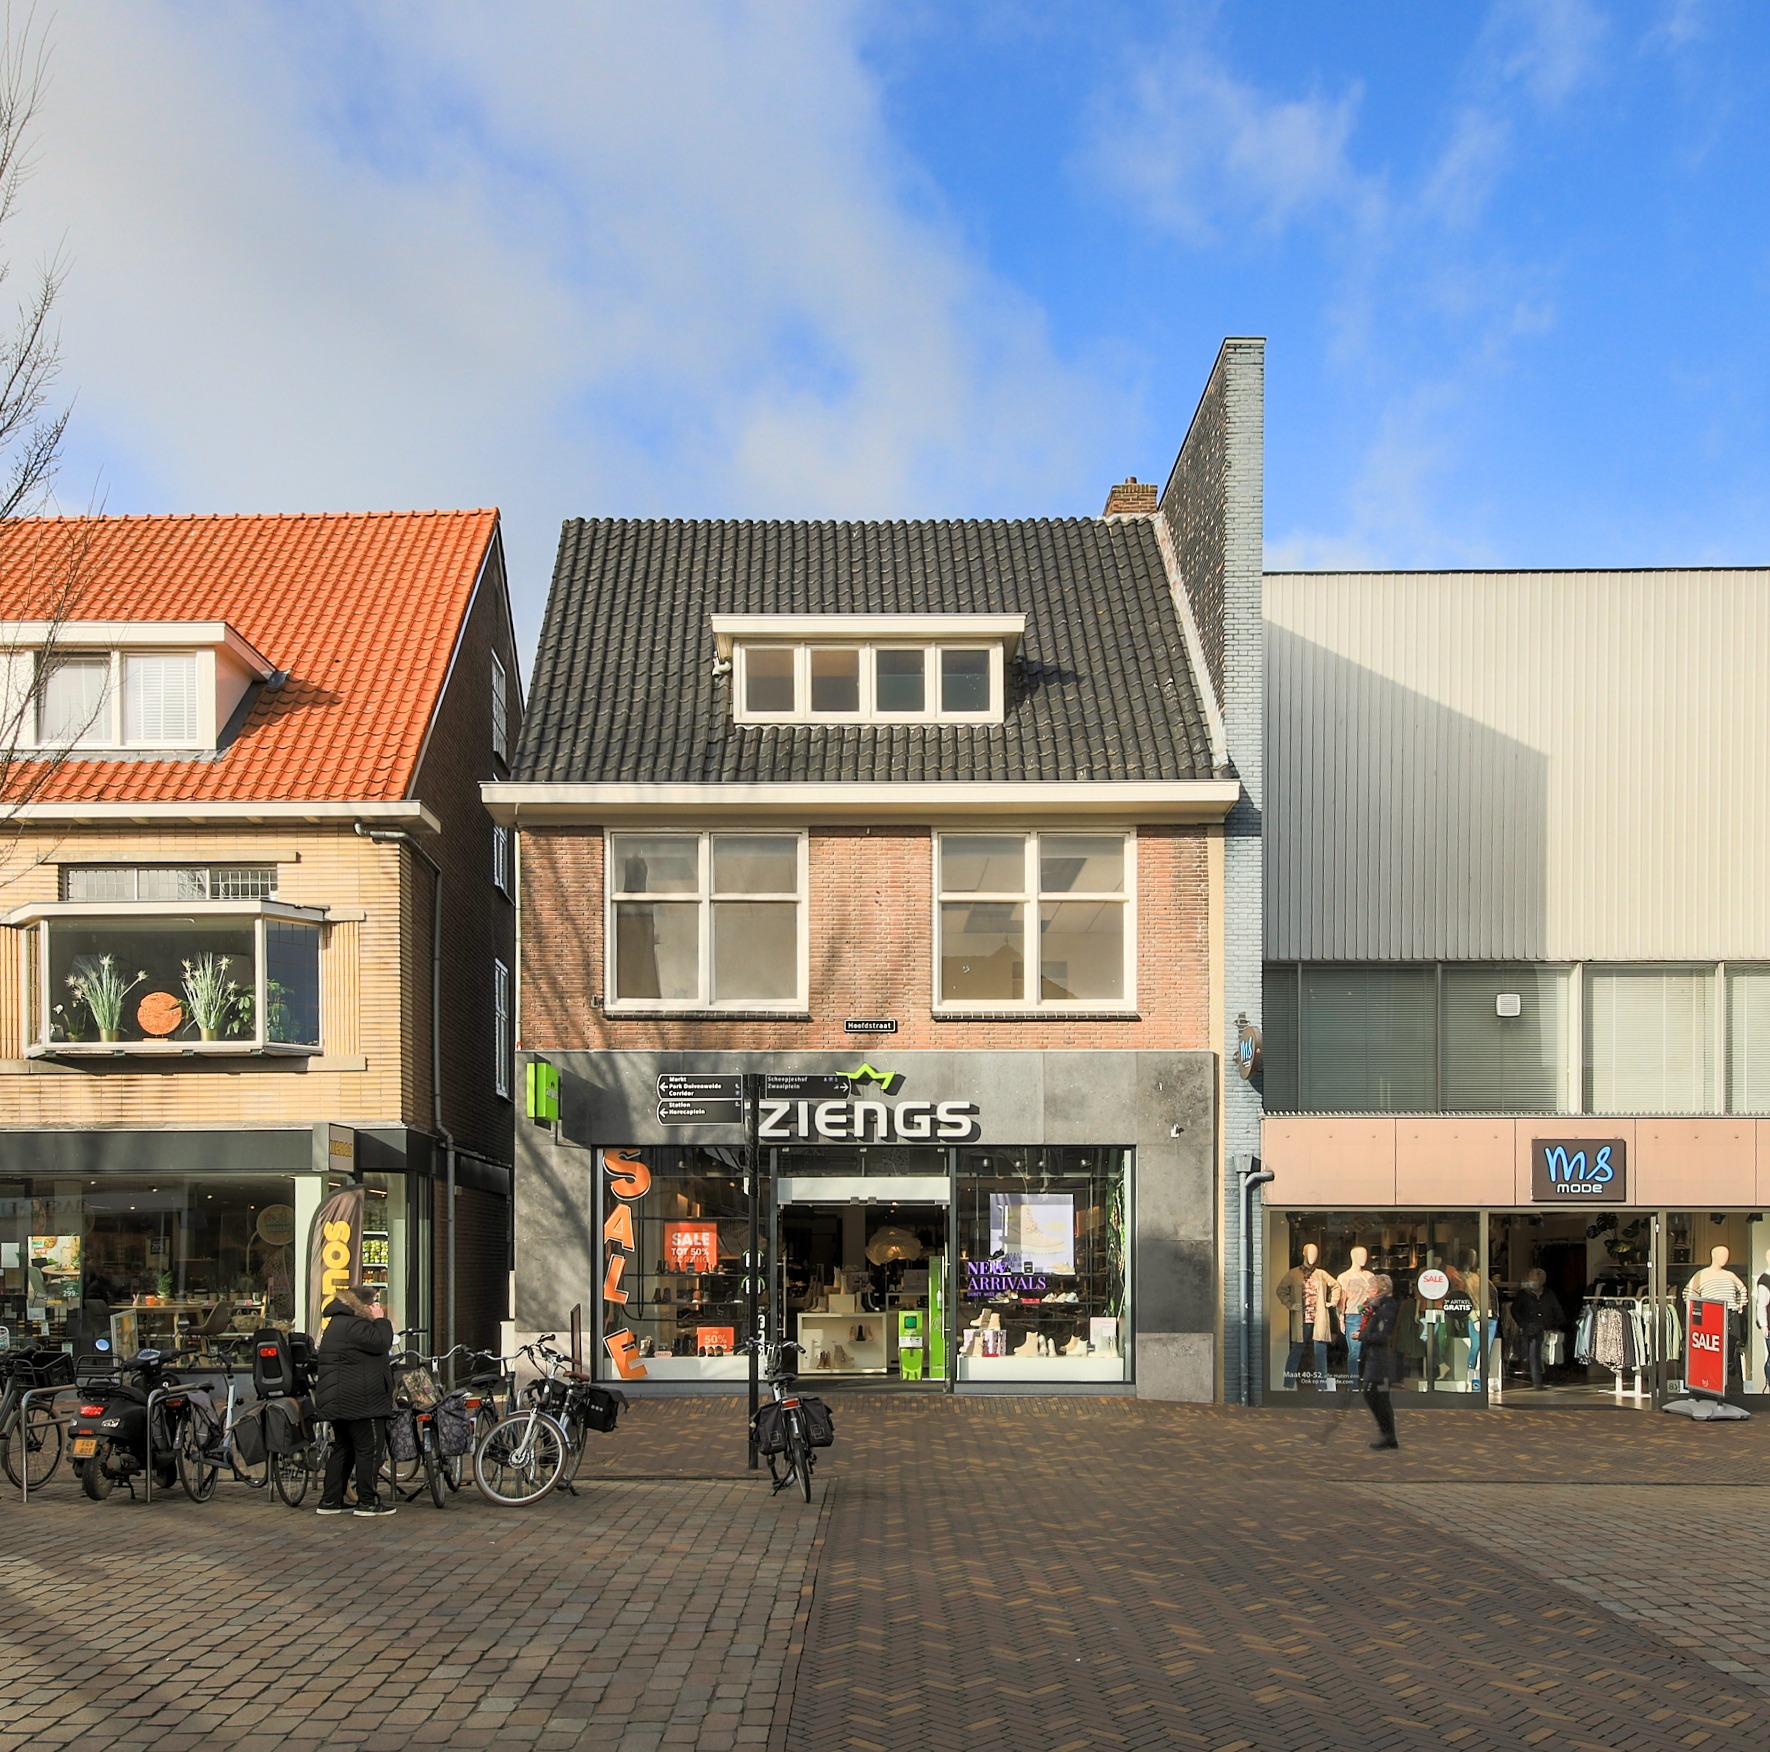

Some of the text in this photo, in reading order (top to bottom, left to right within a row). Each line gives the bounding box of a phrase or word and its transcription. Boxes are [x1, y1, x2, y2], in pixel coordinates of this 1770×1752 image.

[847, 1022, 892, 1030] Hoofdstraat
[668, 1108, 706, 1116] Horecaplein
[757, 1101, 973, 1137] ZIENGS
[671, 1232, 710, 1247] SALE
[670, 1247, 710, 1256] TOT 50%
[602, 1149, 651, 1379] SALE
[967, 1261, 1009, 1275] NEW
[967, 1276, 1047, 1291] ARRIVALS
[1423, 1275, 1444, 1283] SALE
[704, 1334, 728, 1344] 50%
[1692, 1332, 1720, 1352] SALE
